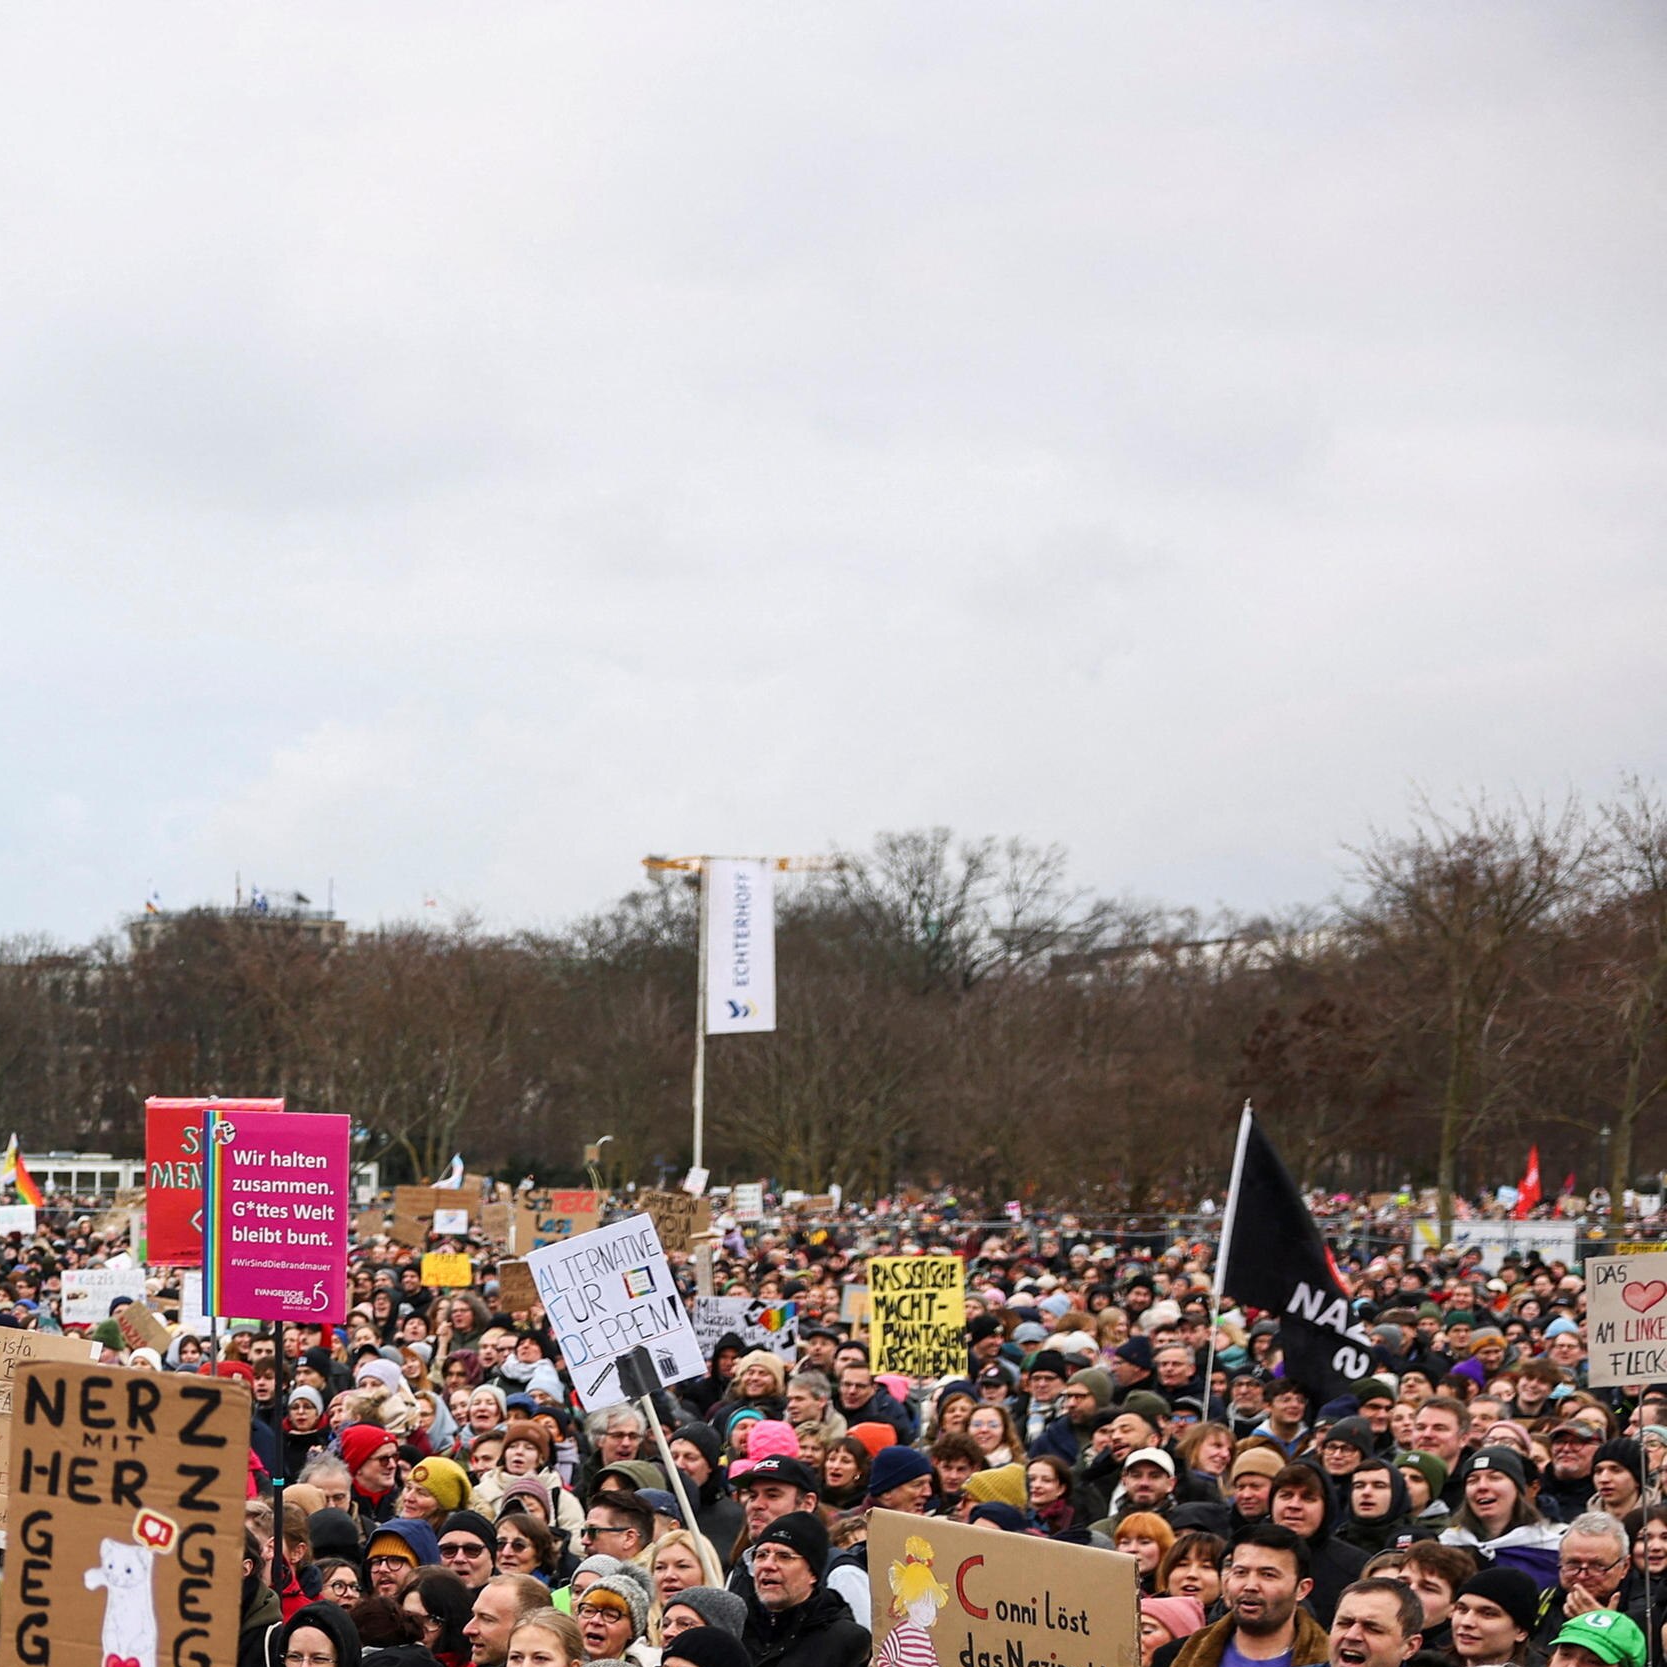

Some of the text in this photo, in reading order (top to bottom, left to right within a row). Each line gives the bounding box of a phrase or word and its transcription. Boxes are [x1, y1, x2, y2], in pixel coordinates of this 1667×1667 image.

[732, 870, 750, 988] ECHTERHOFF
[232, 1149, 328, 1169] Wir halten
[231, 1178, 335, 1196] zusammen.
[292, 1202, 335, 1221] Welt
[231, 1225, 334, 1248] bleibt bunt.
[230, 1258, 332, 1272] #WirSindDieBrandmauer
[538, 1228, 660, 1297] ALTERNATIVE
[1596, 1263, 1628, 1285] DAS
[551, 1282, 603, 1332] FÜR
[1595, 1320, 1617, 1345] AM
[83, 1432, 144, 1454] MIT
[955, 1554, 1037, 1626] Conni
